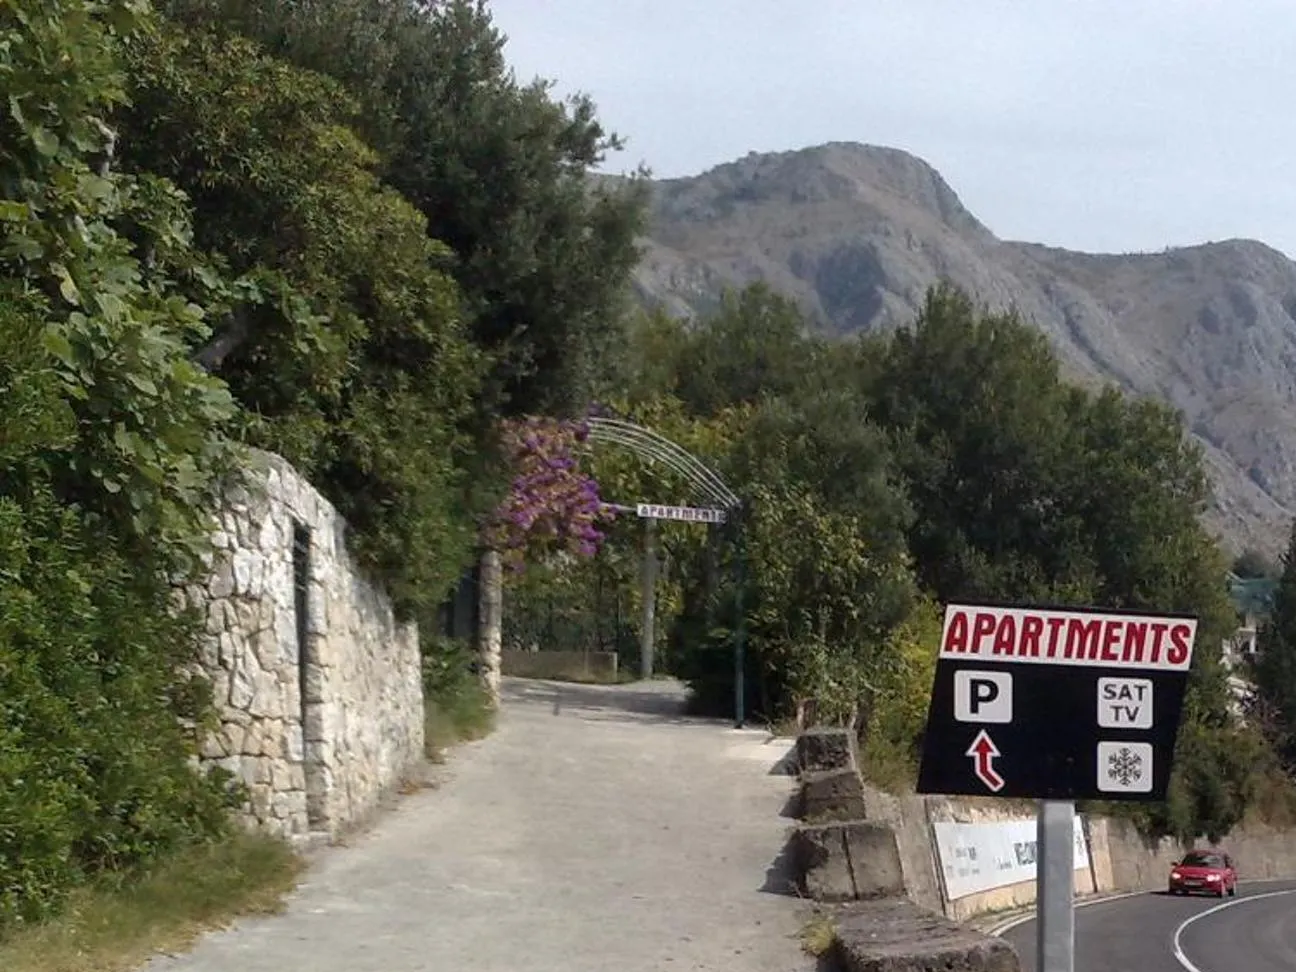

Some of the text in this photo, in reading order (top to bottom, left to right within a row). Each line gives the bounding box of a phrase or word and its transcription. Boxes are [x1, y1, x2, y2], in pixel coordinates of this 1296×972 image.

[945, 611, 1191, 665] APARTMENTS
[968, 678, 999, 714] P
[1103, 683, 1148, 702] SAT
[1109, 706, 1140, 722] TV
